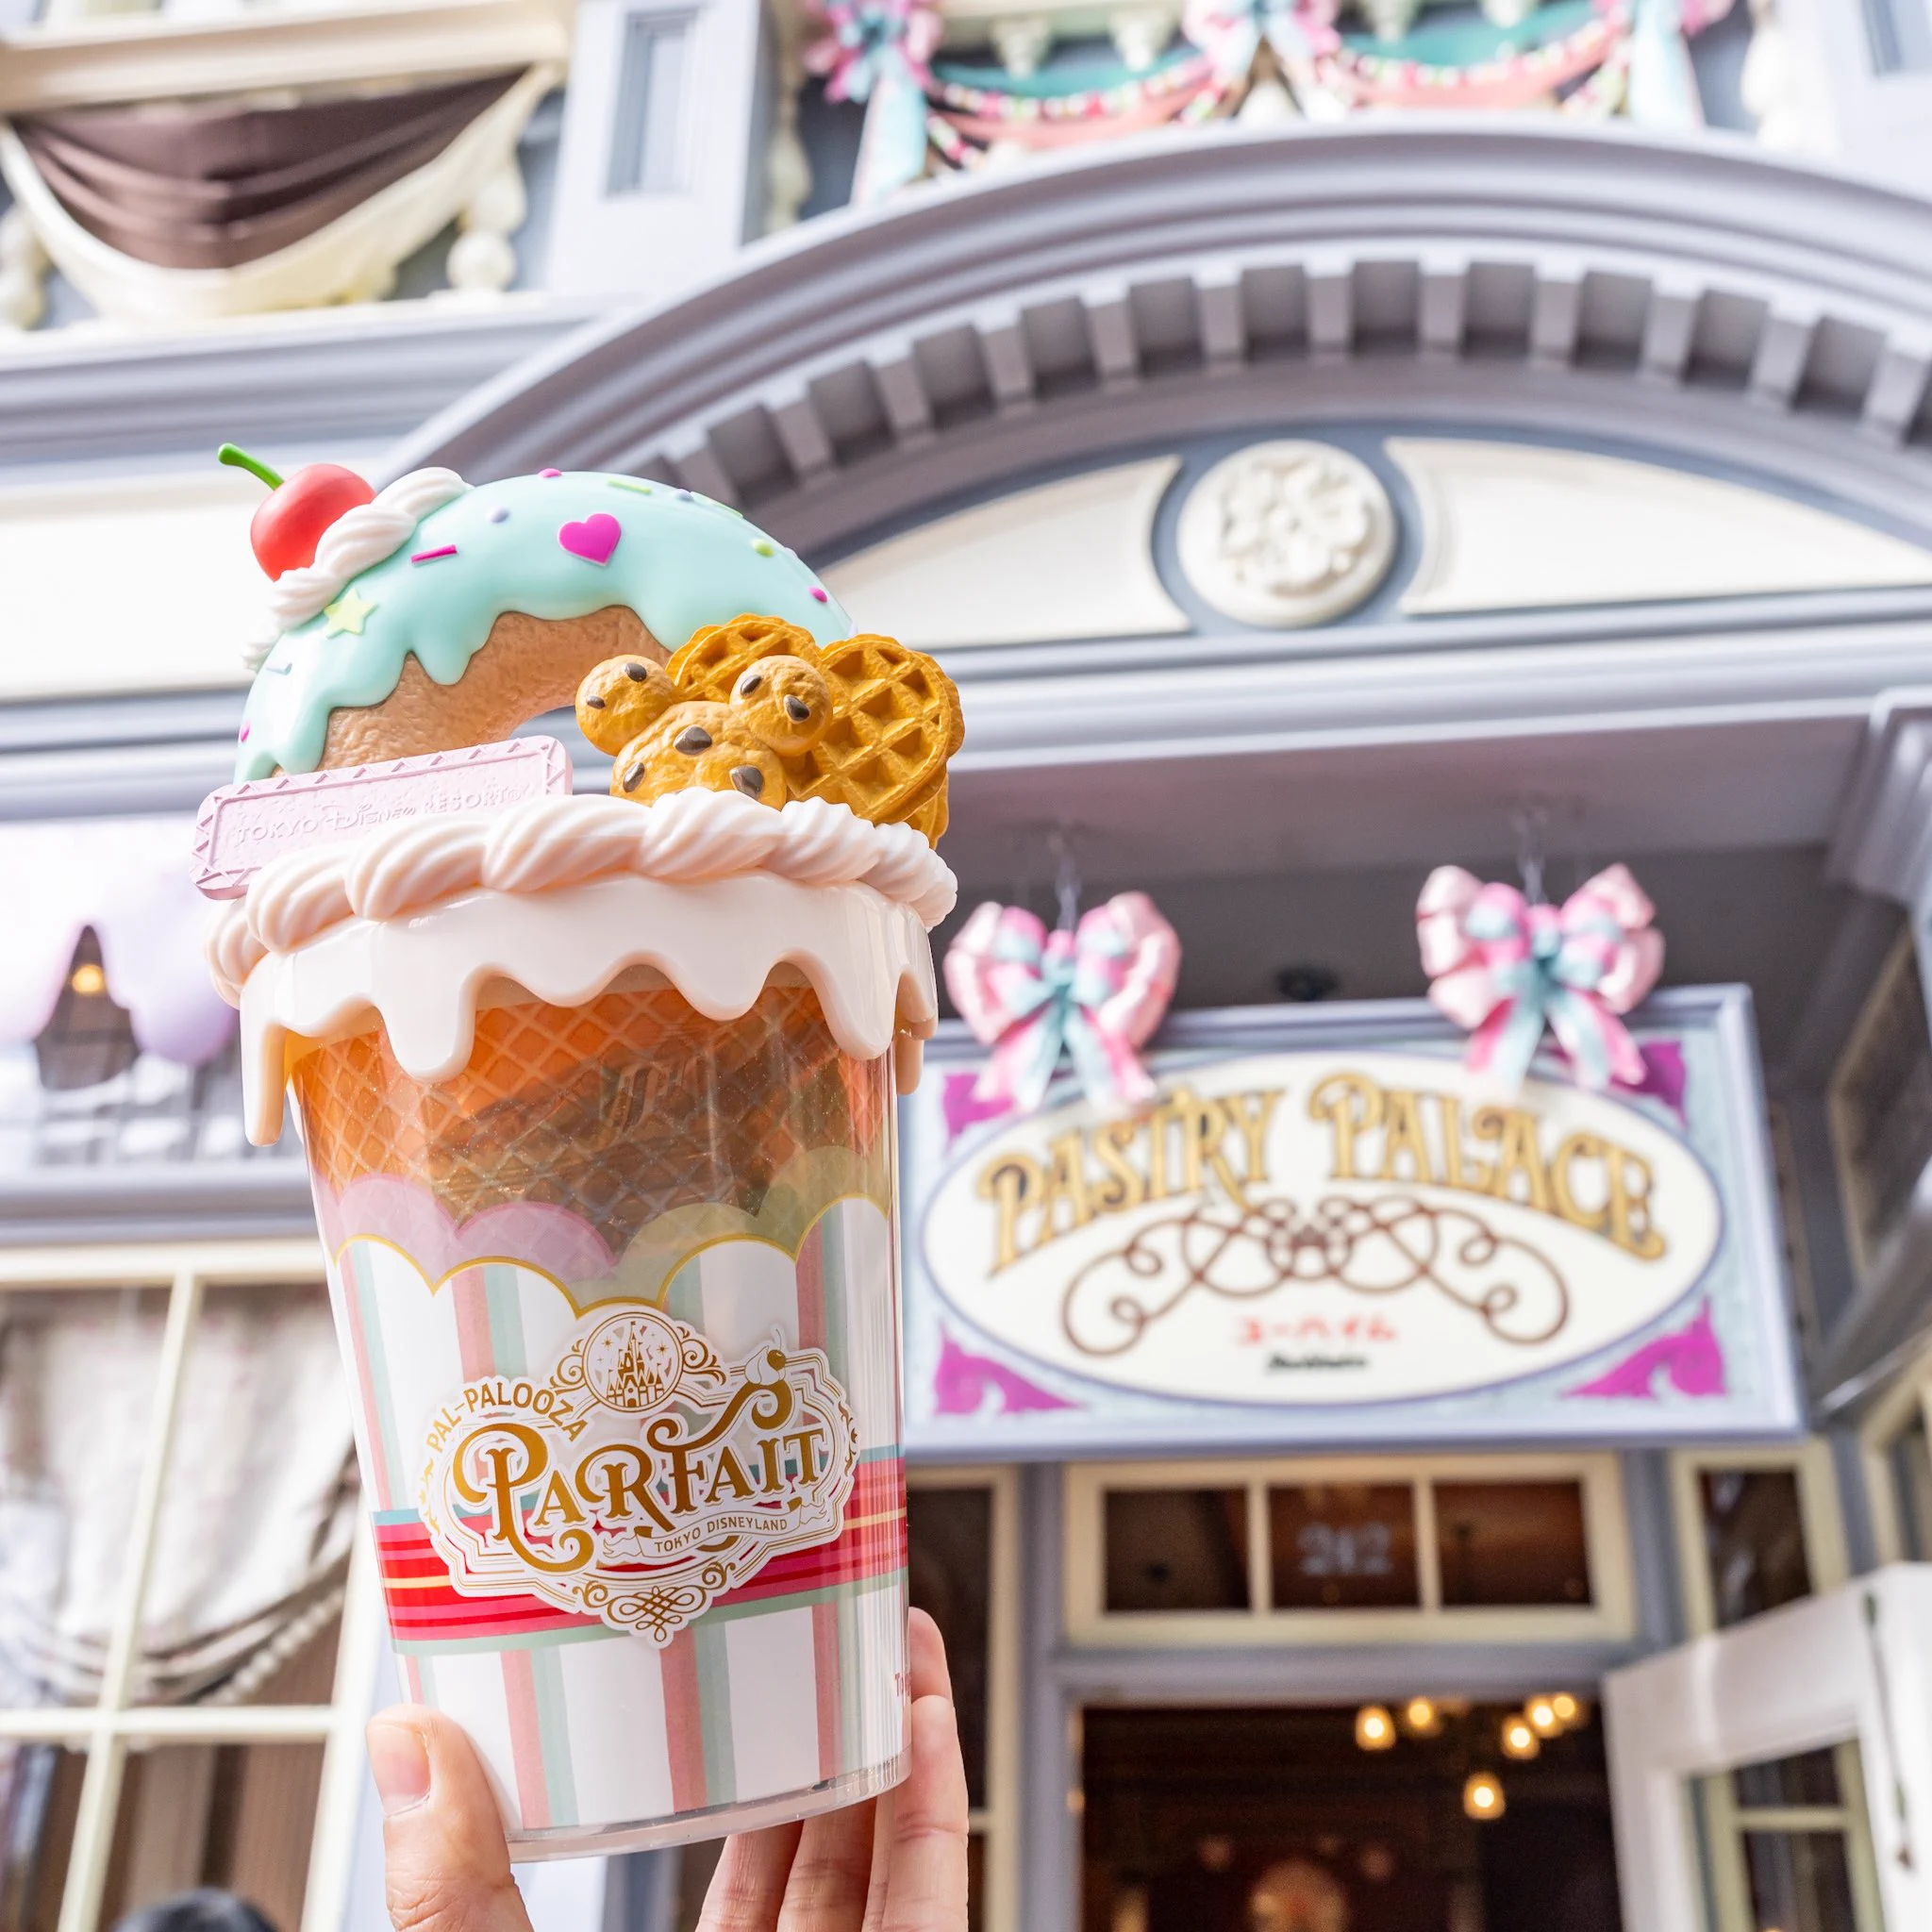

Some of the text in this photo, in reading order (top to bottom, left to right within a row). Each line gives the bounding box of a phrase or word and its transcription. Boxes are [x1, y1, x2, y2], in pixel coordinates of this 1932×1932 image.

[237, 818, 319, 843] TOKYO
[975, 1073, 1666, 1279] PASTRY PALACE
[426, 1382, 588, 1454] PAL-PALOOZA
[655, 1516, 788, 1553] TOKYO DISNEYLAND
